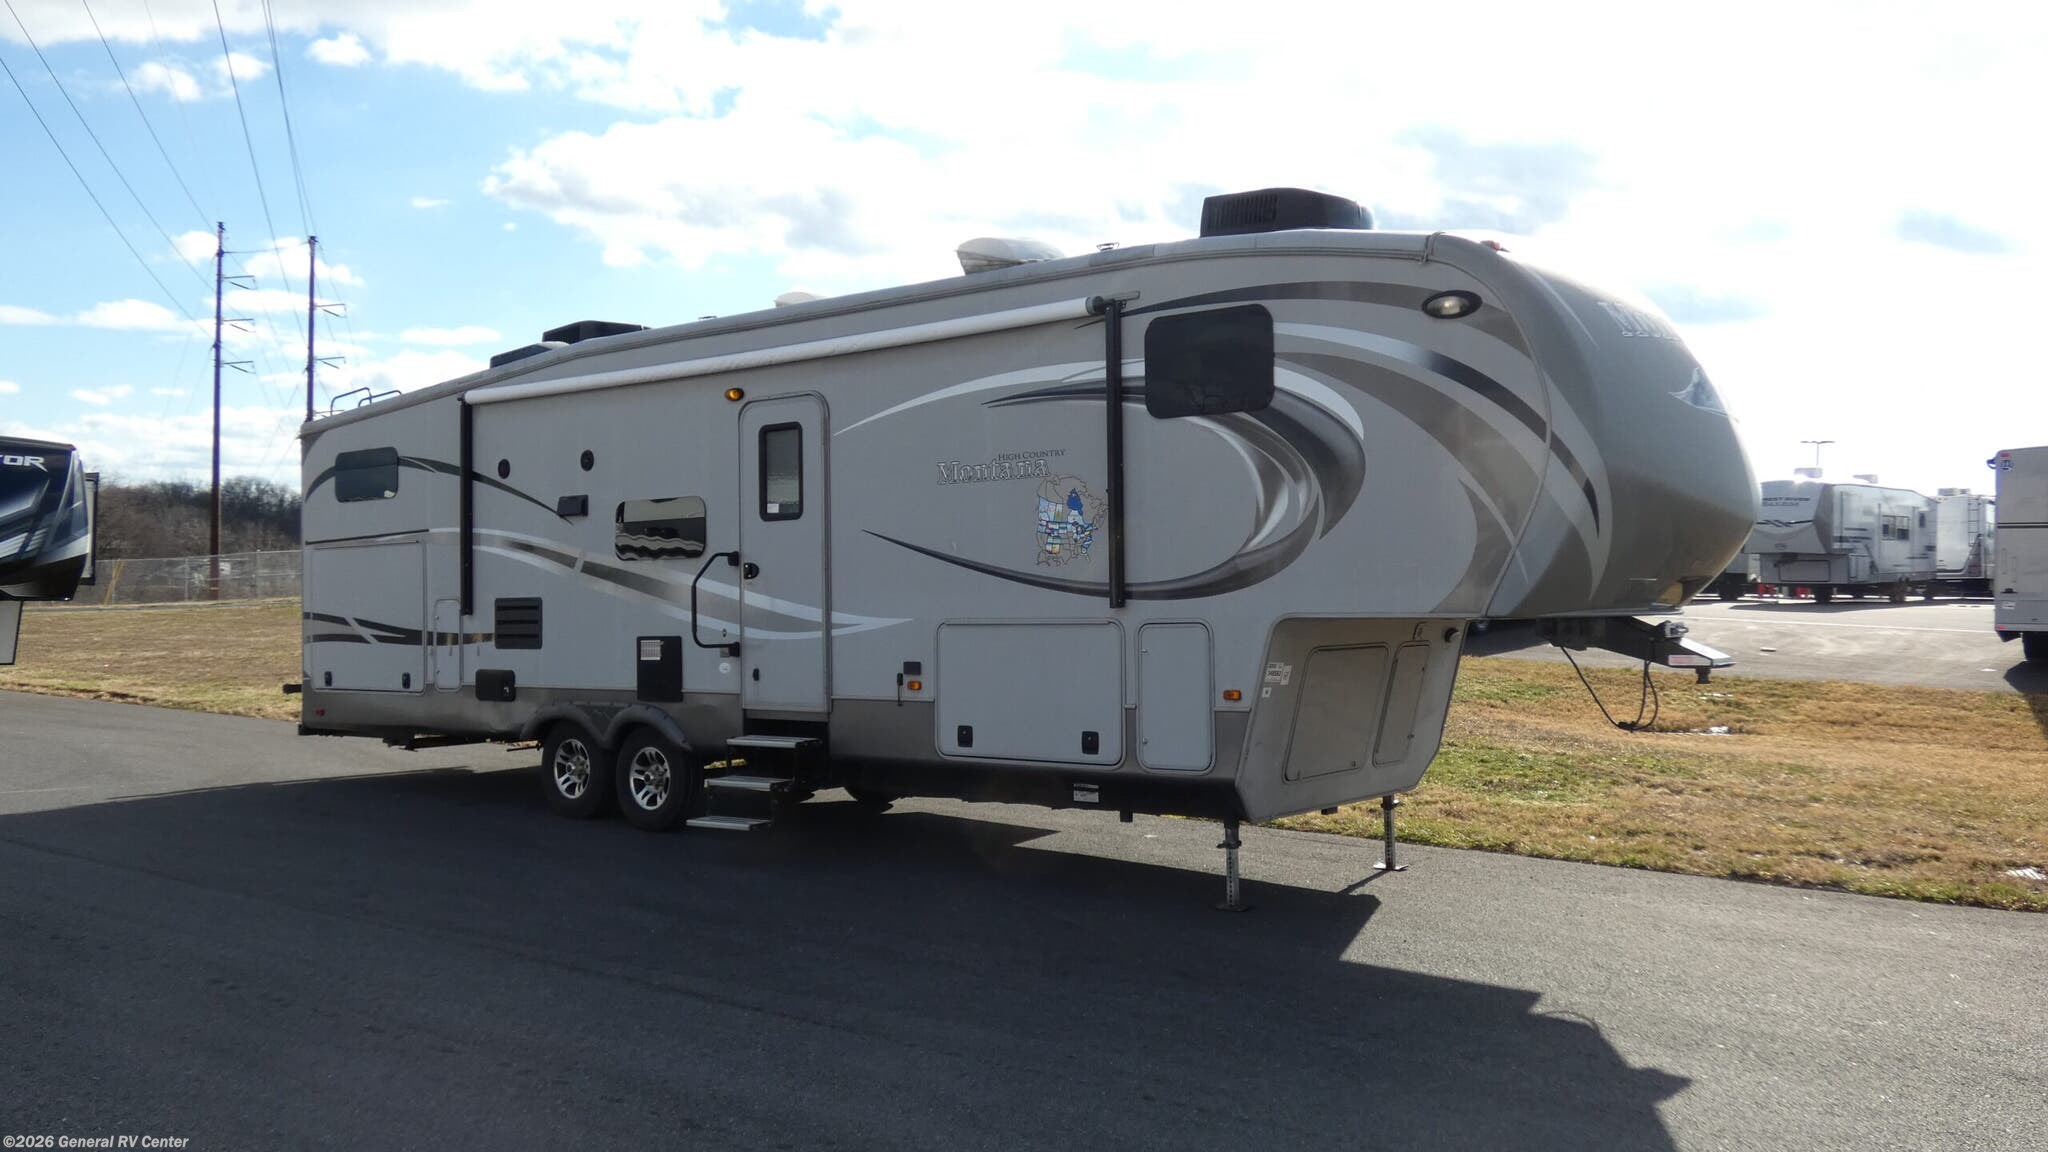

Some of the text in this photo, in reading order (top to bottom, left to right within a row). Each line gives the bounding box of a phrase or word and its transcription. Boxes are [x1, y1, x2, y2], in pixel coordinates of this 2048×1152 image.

[0, 454, 48, 472] OR
[997, 449, 1066, 462] HIGH COUNTRY
[936, 458, 1051, 485] Montana
